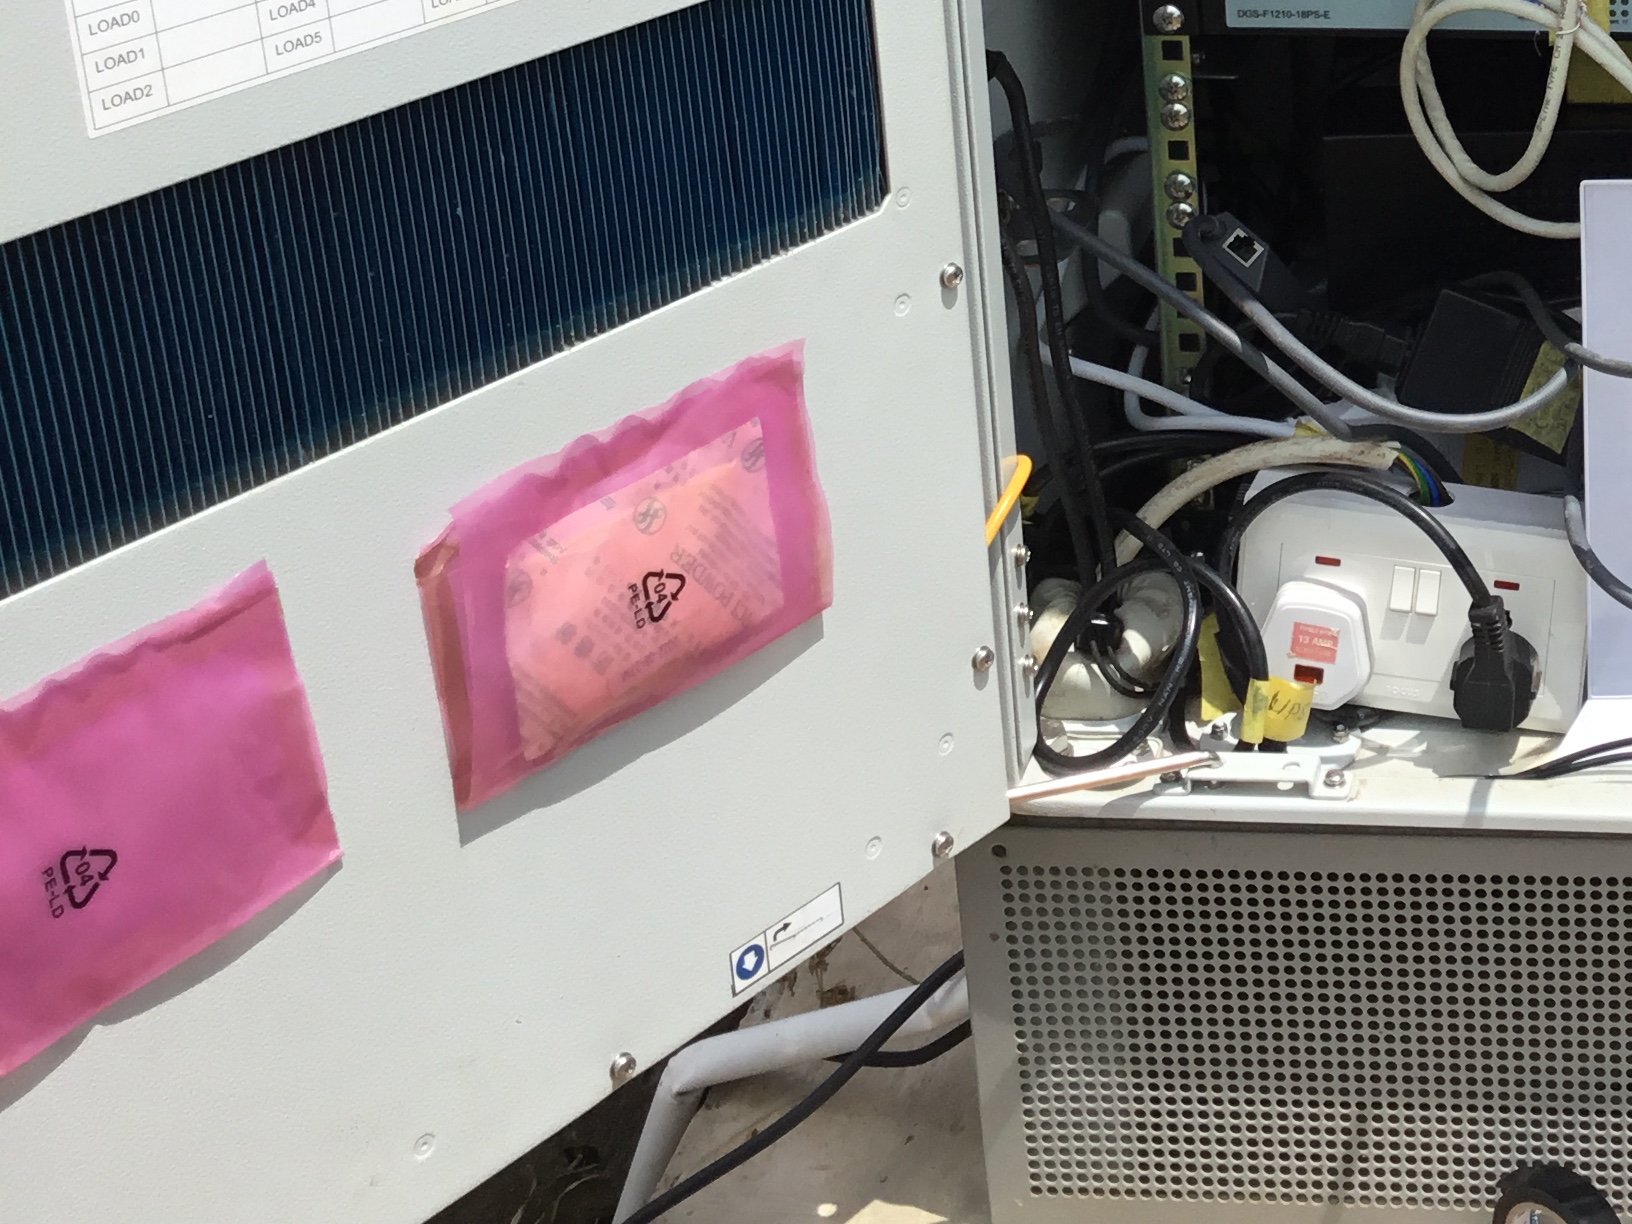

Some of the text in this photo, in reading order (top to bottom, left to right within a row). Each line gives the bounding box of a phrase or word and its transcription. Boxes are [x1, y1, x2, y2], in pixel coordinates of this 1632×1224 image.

[88, 10, 141, 36] LOAD0
[1237, 9, 1331, 20] DGS-F1210-18PS-E
[274, 31, 322, 56] LOAD5
[94, 48, 146, 74] LOAD1
[101, 84, 154, 111] LOAD2
[627, 582, 646, 629] PE-LD
[653, 582, 668, 604] 04
[1298, 635, 1311, 644] 13
[75, 861, 95, 886] 04
[42, 866, 65, 919] PE-LD
